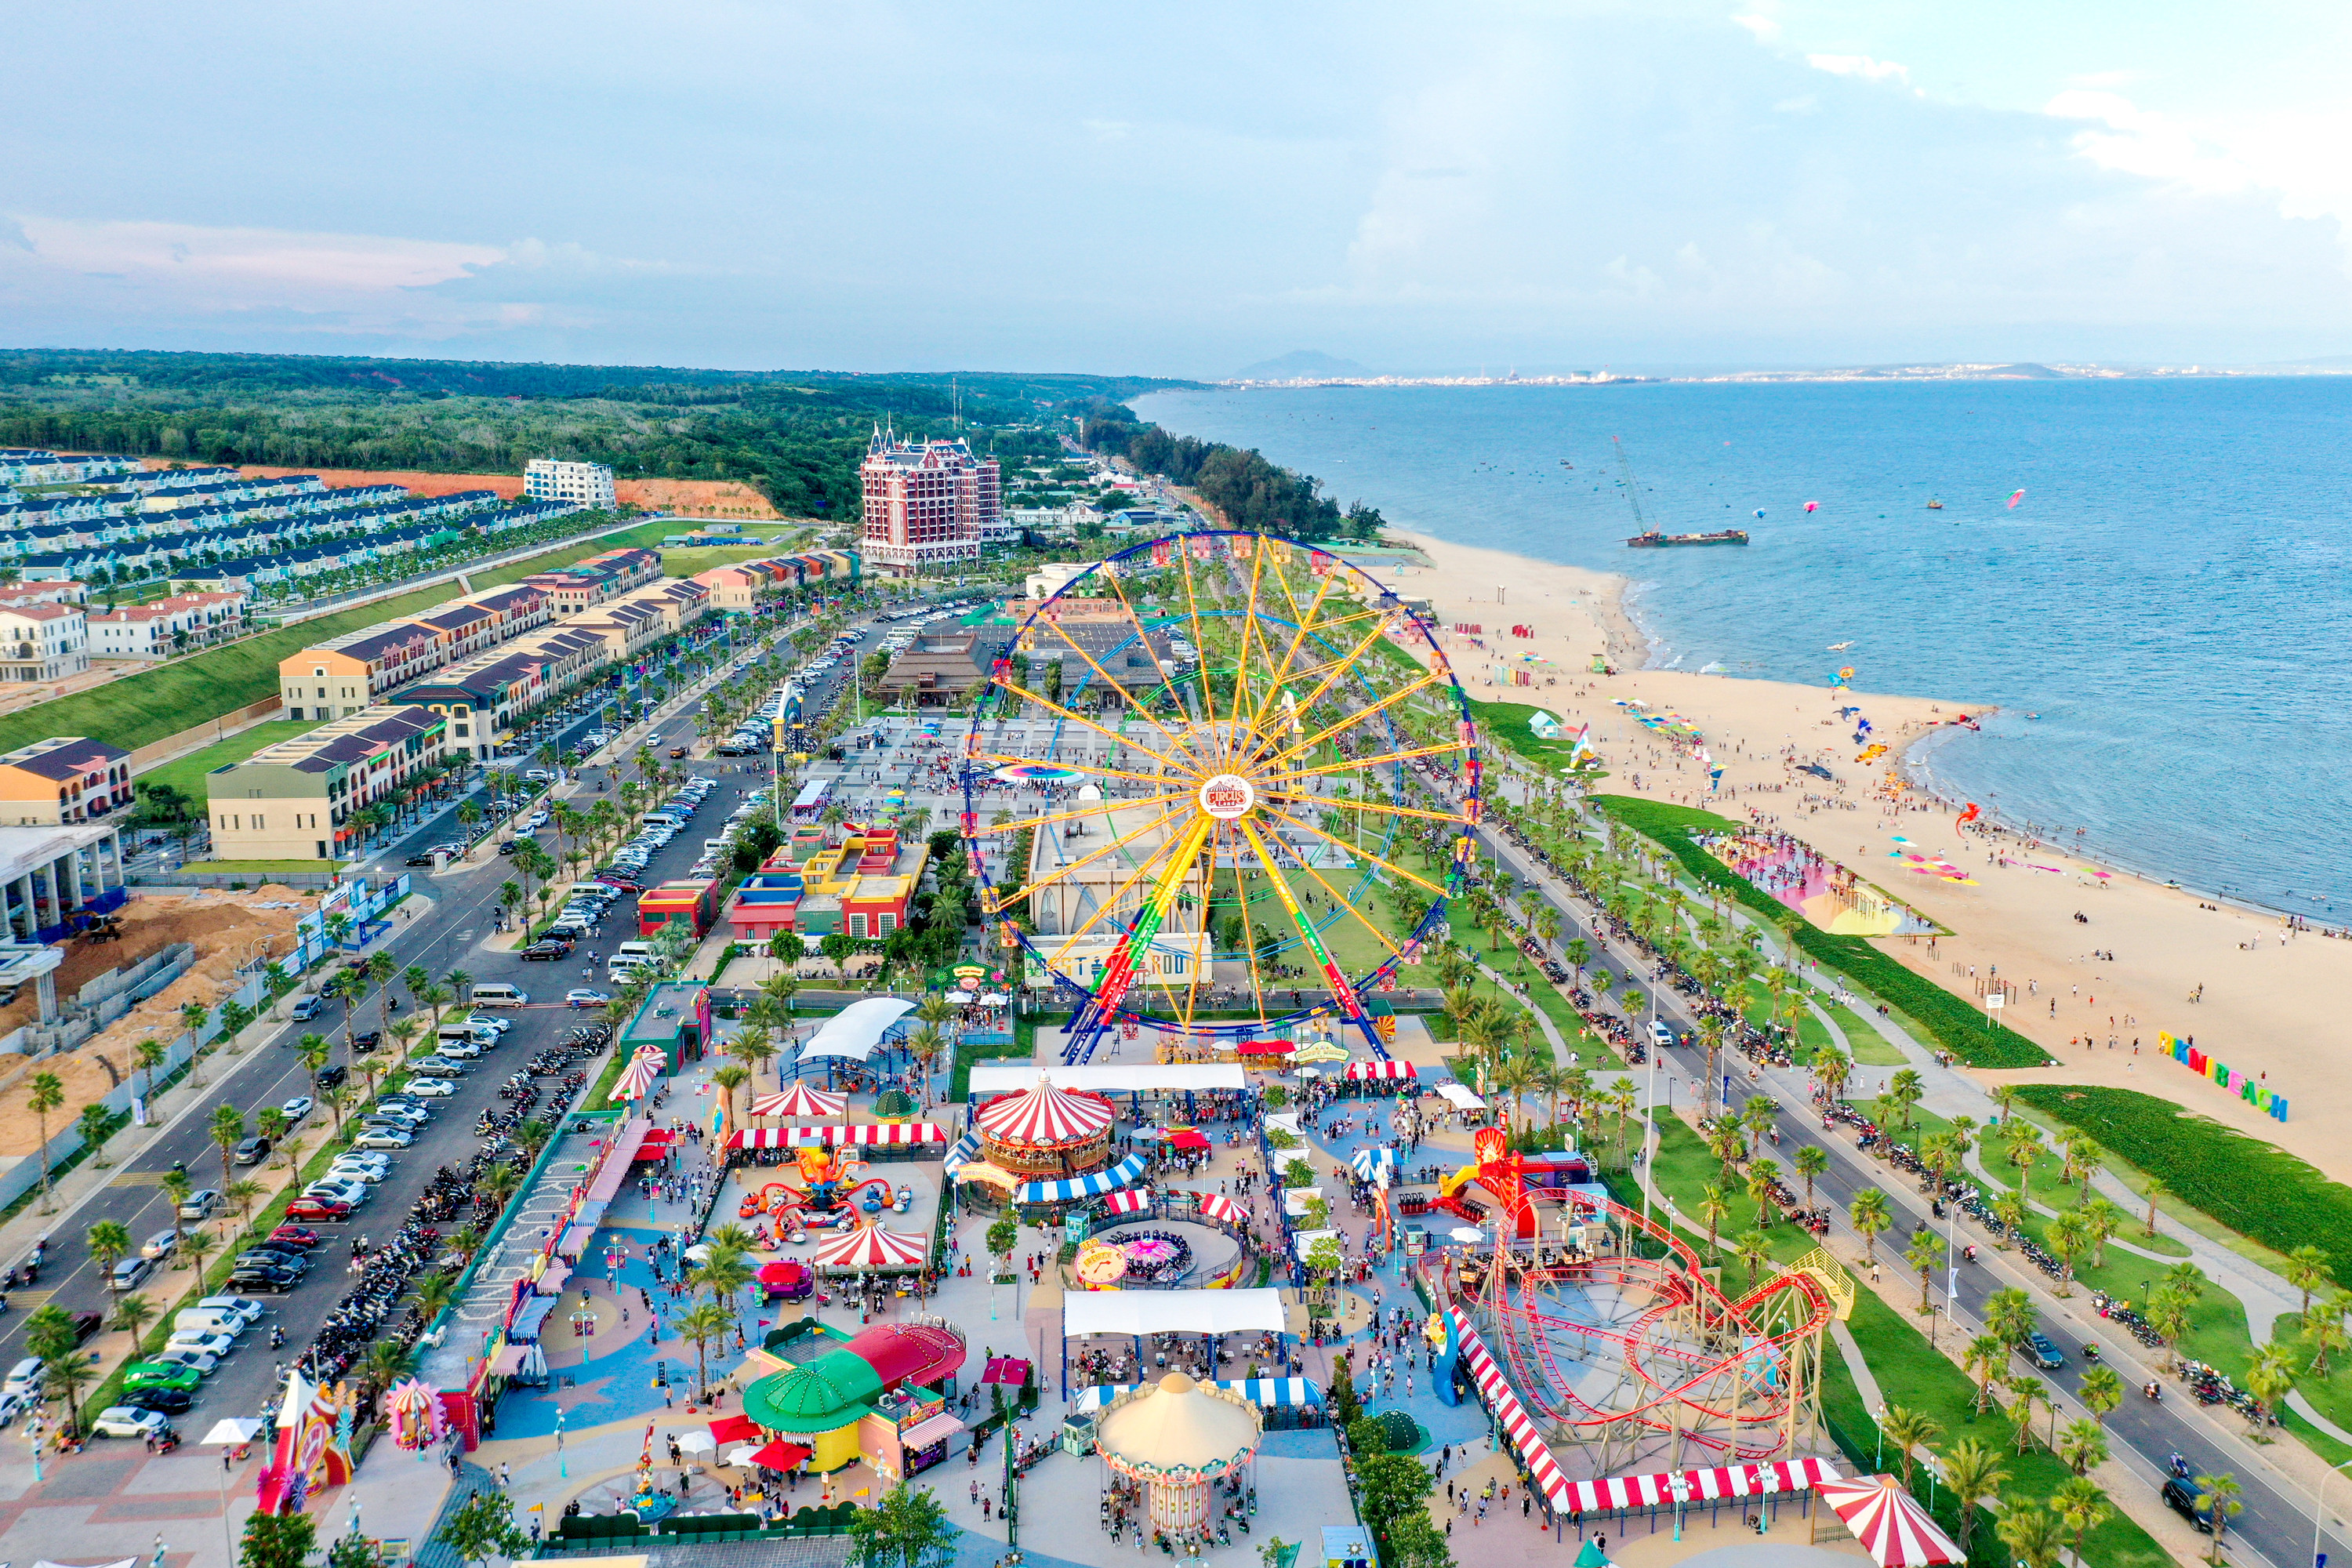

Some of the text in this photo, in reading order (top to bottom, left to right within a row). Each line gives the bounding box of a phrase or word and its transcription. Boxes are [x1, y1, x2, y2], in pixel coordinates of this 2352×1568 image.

[1207, 789, 1247, 806] CIRCUS
[2158, 1029, 2288, 1123] BIKINI BEACH
[1079, 1238, 1099, 1251] UFO
